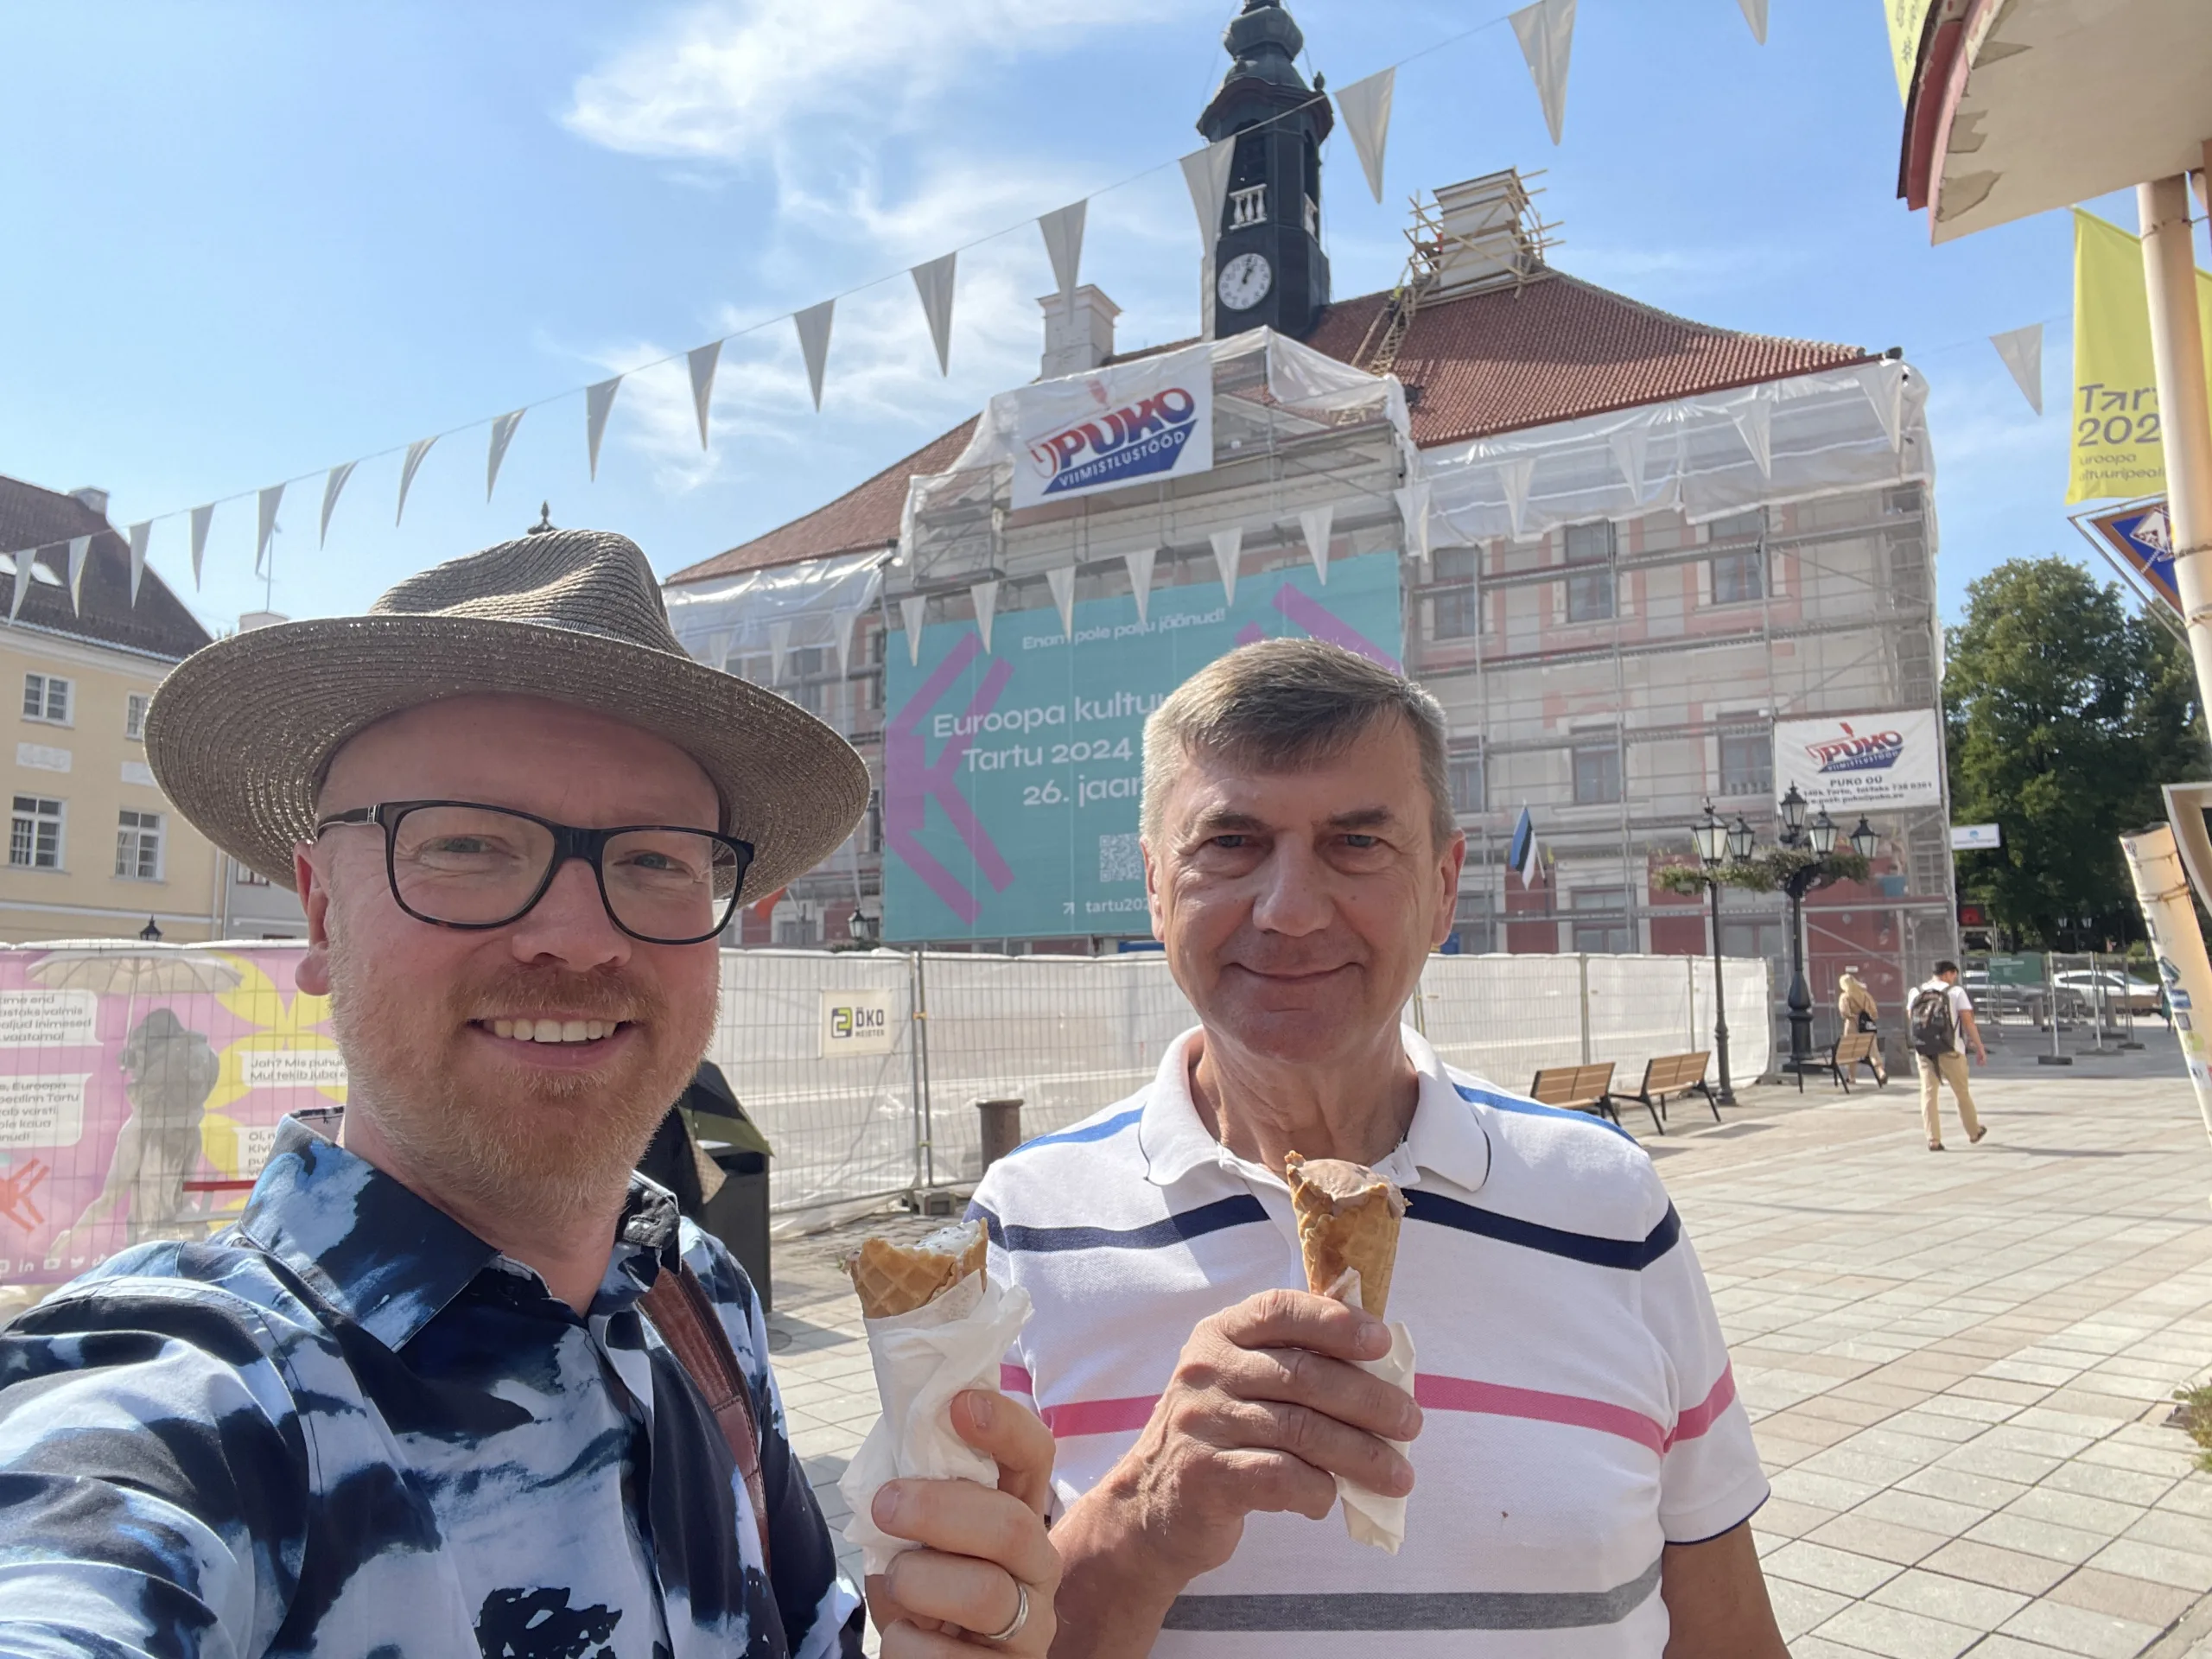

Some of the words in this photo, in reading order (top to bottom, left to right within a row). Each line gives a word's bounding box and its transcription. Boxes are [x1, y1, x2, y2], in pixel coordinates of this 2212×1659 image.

[1048, 388, 1195, 471] PUKO
[1058, 431, 1185, 487] VIIMISTLUSTÖÖD
[1074, 626, 1110, 645] pole
[1158, 608, 1226, 633] jäänud!
[933, 704, 1065, 738] Euroopa
[962, 744, 1043, 772] Tartu
[1051, 738, 1134, 763] 2024
[1821, 731, 1903, 762] PUKO
[1022, 779, 1070, 805] 26.
[1829, 778, 1862, 787] PUKO
[43, 1005, 83, 1016] valmis
[855, 1007, 885, 1027] ÖKO
[35, 1017, 92, 1028] inimesed
[285, 1058, 307, 1068] Mis
[12, 1082, 67, 1091] Euroopa
[47, 1093, 79, 1103] Tartu
